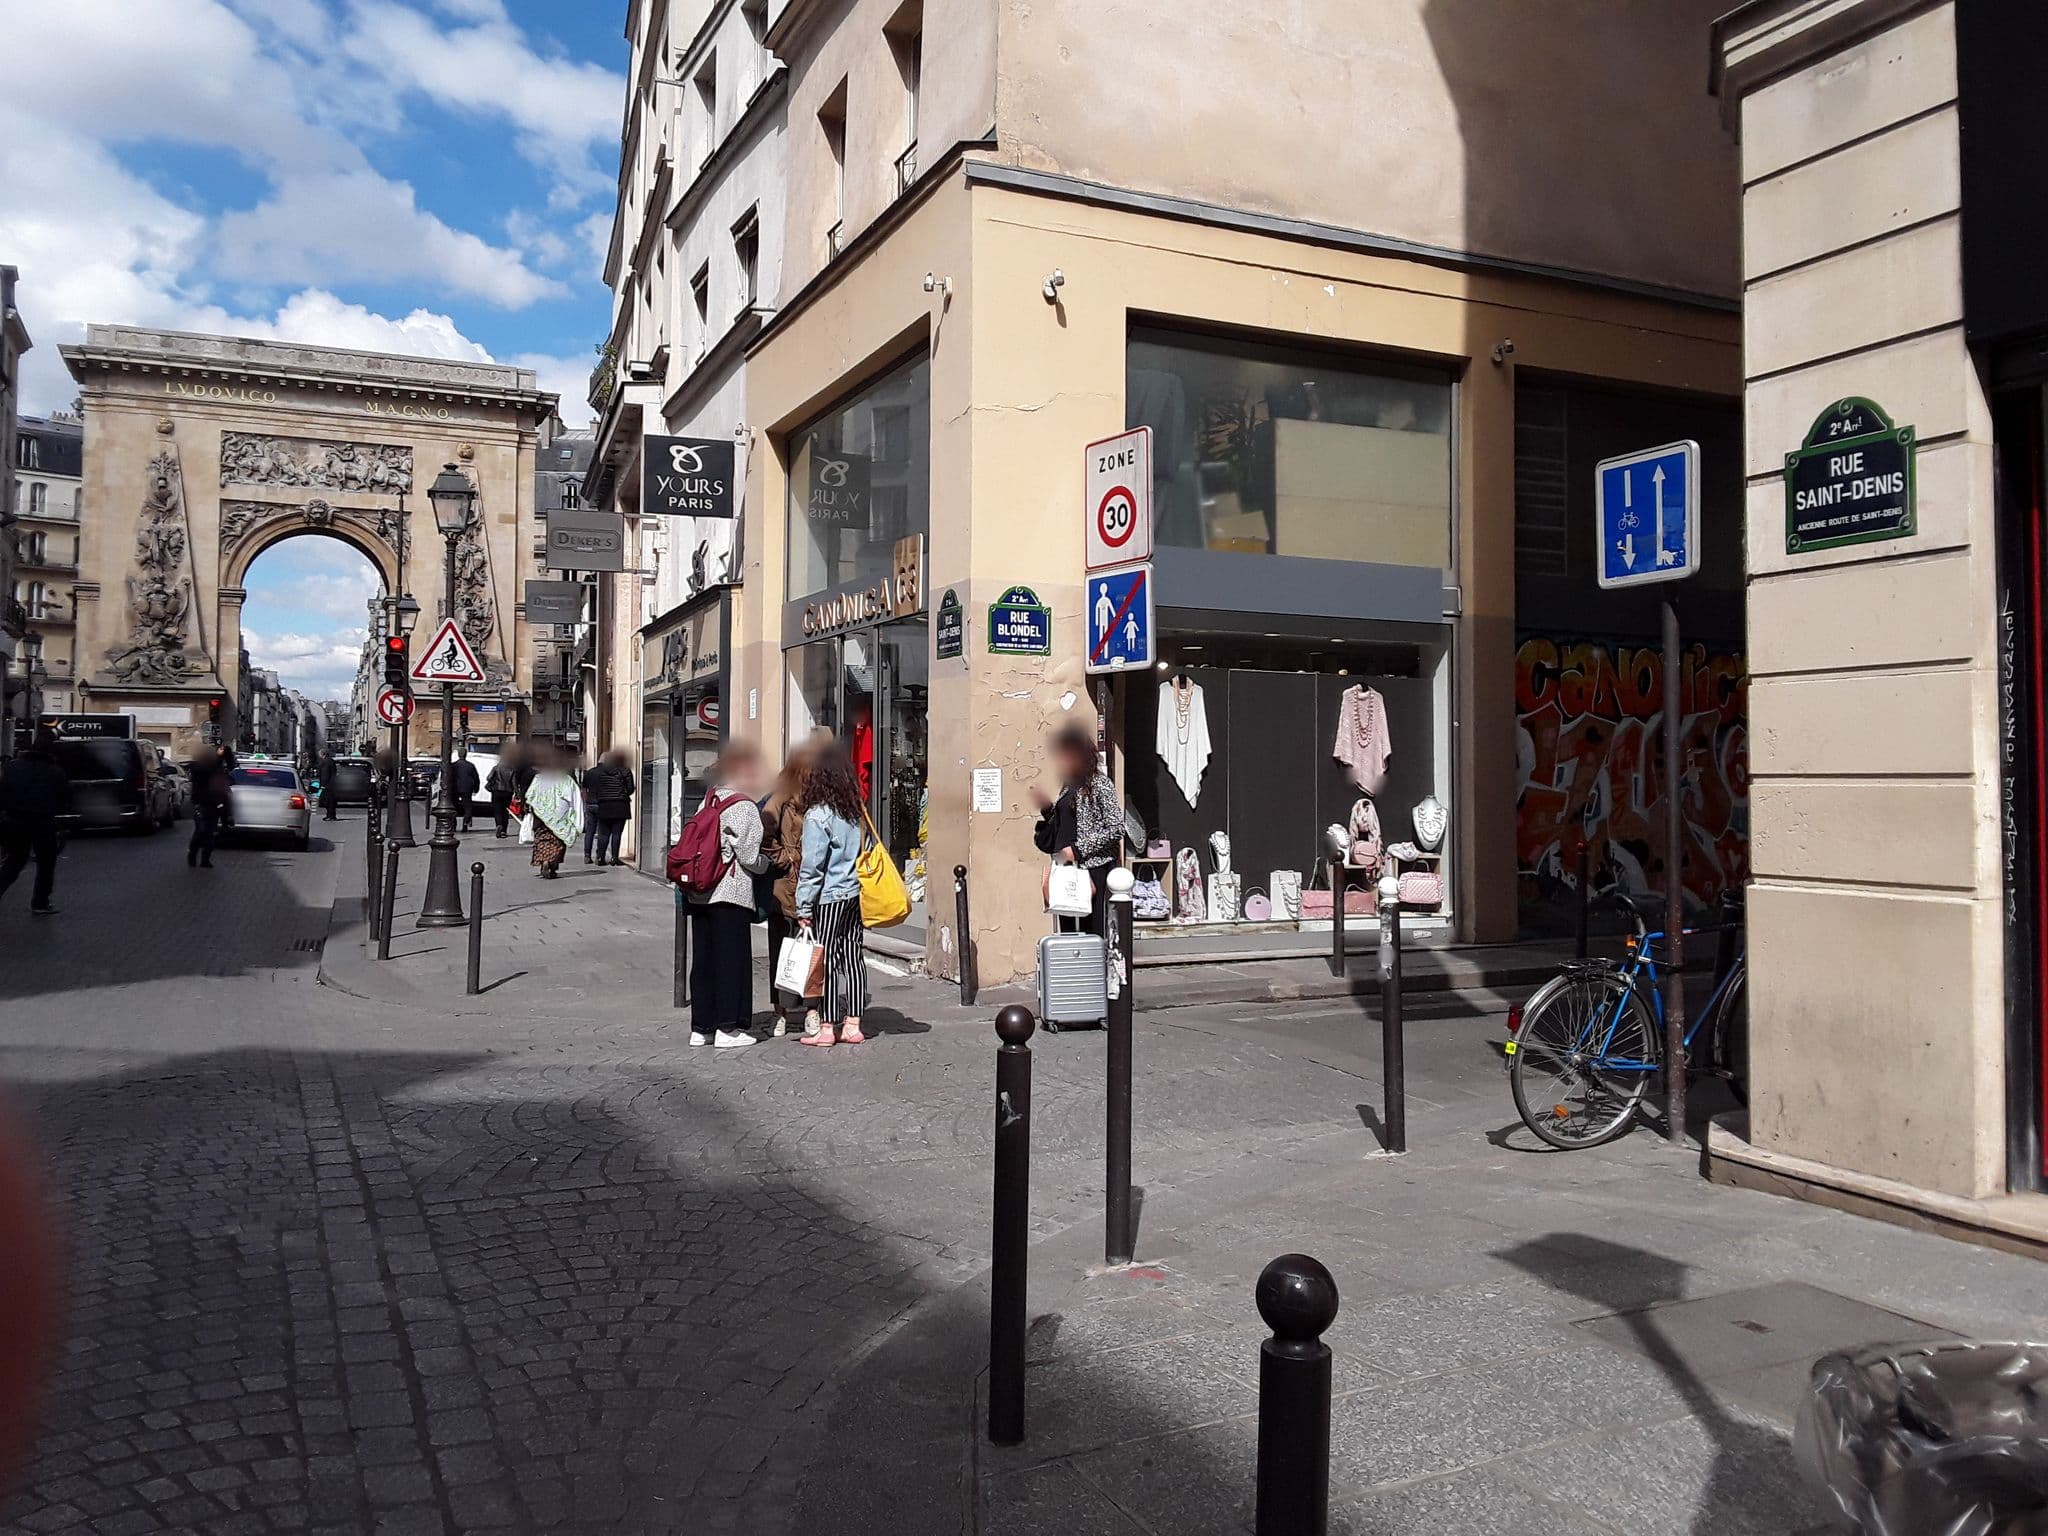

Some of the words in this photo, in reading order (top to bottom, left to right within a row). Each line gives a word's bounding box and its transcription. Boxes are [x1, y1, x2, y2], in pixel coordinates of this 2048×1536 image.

[165, 382, 276, 402] LVDOVICO
[366, 401, 449, 419] MAGNO
[1099, 449, 1135, 473] ZONE
[1829, 452, 1864, 477] RUE
[656, 475, 724, 496] YOURS
[1795, 472, 1904, 511] SAINT-DENIS
[668, 496, 713, 510] PARIS
[1106, 503, 1129, 530] 30
[1797, 519, 1827, 532] ANCIENNE
[1828, 515, 1850, 528] ROUTE
[1851, 513, 1861, 523] DE
[1862, 506, 1903, 521] SAINT-DENIS
[802, 577, 892, 638] CANONICA
[1010, 611, 1030, 624] RUE
[997, 623, 1042, 638] BLONDEL
